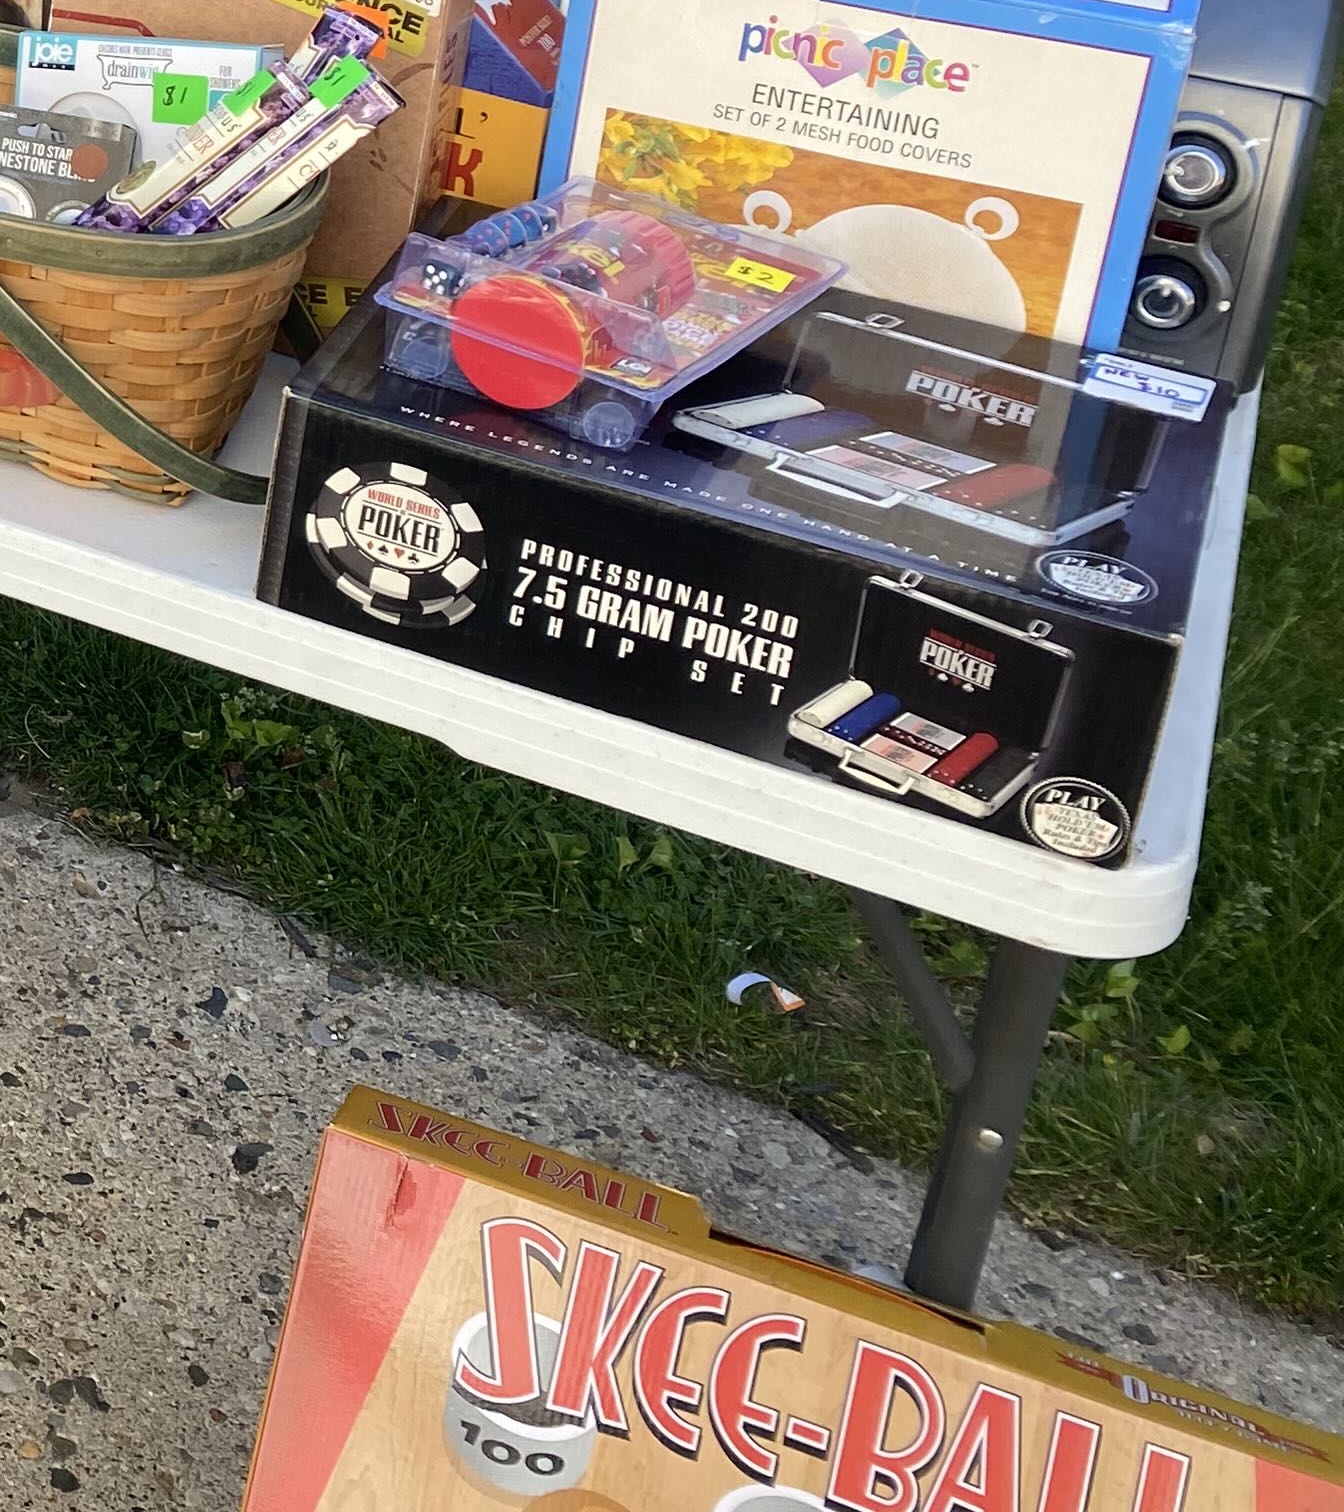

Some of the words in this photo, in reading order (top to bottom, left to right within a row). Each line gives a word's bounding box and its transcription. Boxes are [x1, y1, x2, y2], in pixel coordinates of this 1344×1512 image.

[31, 37, 73, 67] joie
[737, 14, 845, 71] picnic
[866, 39, 971, 93] place
[712, 103, 745, 122] SET
[750, 111, 772, 127] OF
[775, 117, 787, 132] 2
[792, 122, 842, 145] MESH
[847, 131, 894, 155] FOOD
[900, 140, 972, 169] COVERS
[752, 83, 940, 139] ENTERTAINING
[2, 137, 30, 153] PUSH
[32, 141, 45, 156] TO
[46, 147, 73, 161] STAR
[736, 265, 776, 284] $2
[906, 372, 1037, 426] POKER
[368, 489, 403, 508] WORLD
[406, 499, 441, 519] SERIES
[400, 405, 476, 432] WHERE
[488, 431, 593, 465] LEGENDS
[605, 464, 650, 481] ARE
[663, 480, 728, 503] MADE
[742, 503, 790, 520] ONE
[803, 519, 871, 543] HAND
[885, 542, 913, 553] AT
[958, 561, 1018, 583] TIME
[358, 504, 440, 553] POKER
[520, 538, 725, 618] PROFESSIONAL
[741, 602, 799, 639] 200
[1061, 556, 1126, 575] PLAY
[512, 566, 568, 610] 7.5
[576, 584, 675, 642] GRAM
[682, 615, 794, 678] POKER
[920, 639, 995, 688] POKER
[1045, 789, 1106, 811] PLAY
[1122, 1375, 1265, 1436] ORIGINAL
[461, 1419, 565, 1476] 100
